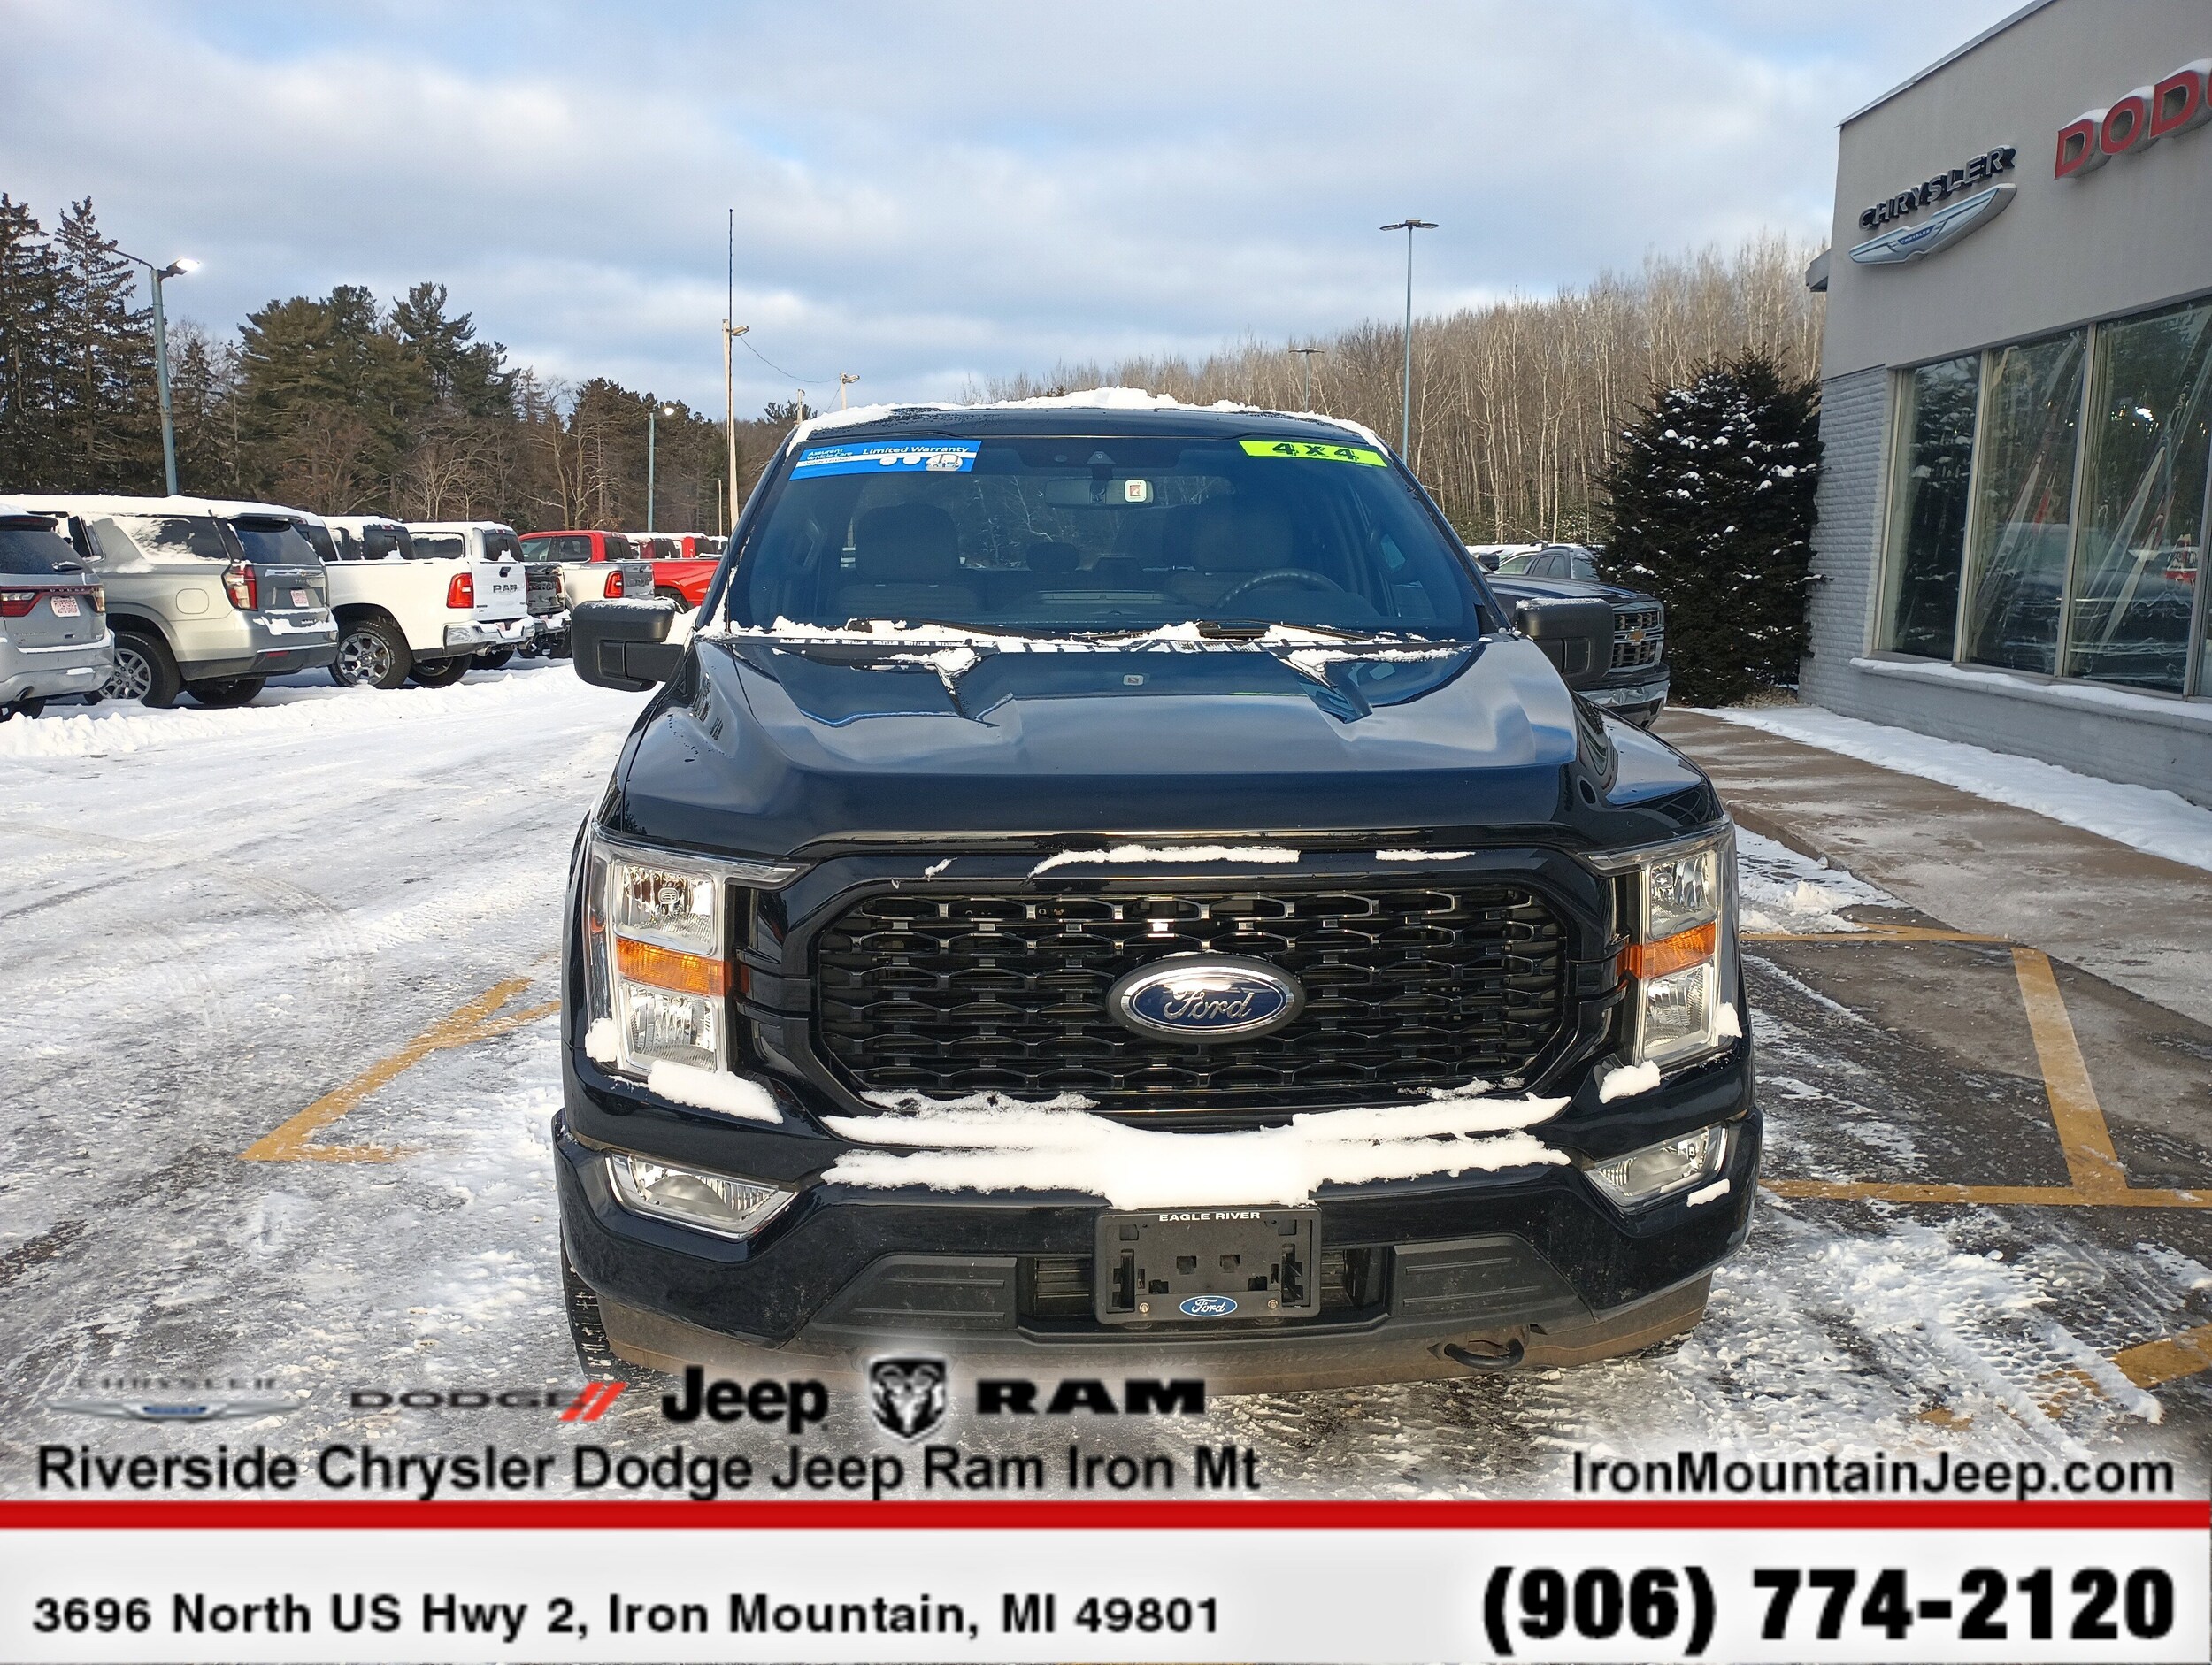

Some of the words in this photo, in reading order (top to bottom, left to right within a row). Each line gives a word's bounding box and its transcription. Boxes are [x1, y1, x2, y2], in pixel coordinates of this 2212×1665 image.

[2054, 69, 2212, 180] DOD
[1858, 146, 2015, 230] CHRYSLER
[1163, 987, 1254, 1020] Ford
[1158, 1213, 1210, 1222] EAGLE
[1215, 1212, 1261, 1221] RIVER
[1191, 1298, 1226, 1313] Ford
